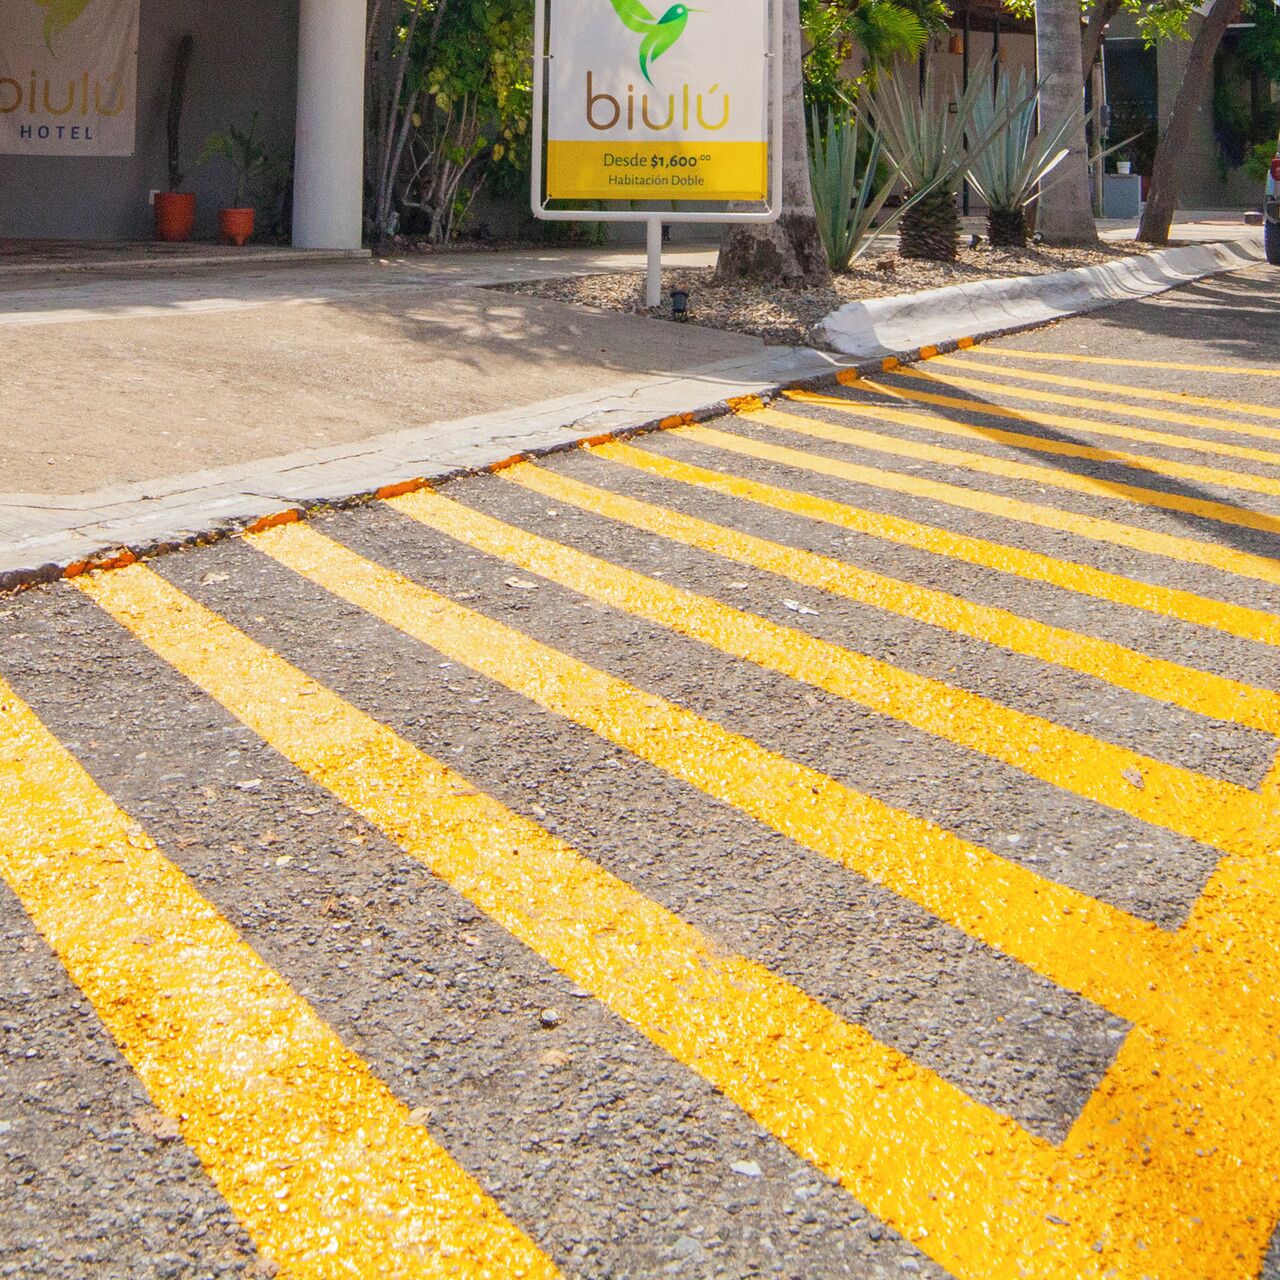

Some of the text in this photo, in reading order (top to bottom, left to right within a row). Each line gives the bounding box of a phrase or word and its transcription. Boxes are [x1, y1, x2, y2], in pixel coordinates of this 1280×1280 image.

[586, 70, 730, 131] biulú
[20, 125, 93, 140] HOTEL
[603, 153, 647, 167] Desde
[608, 174, 705, 186] Habitación Doble
